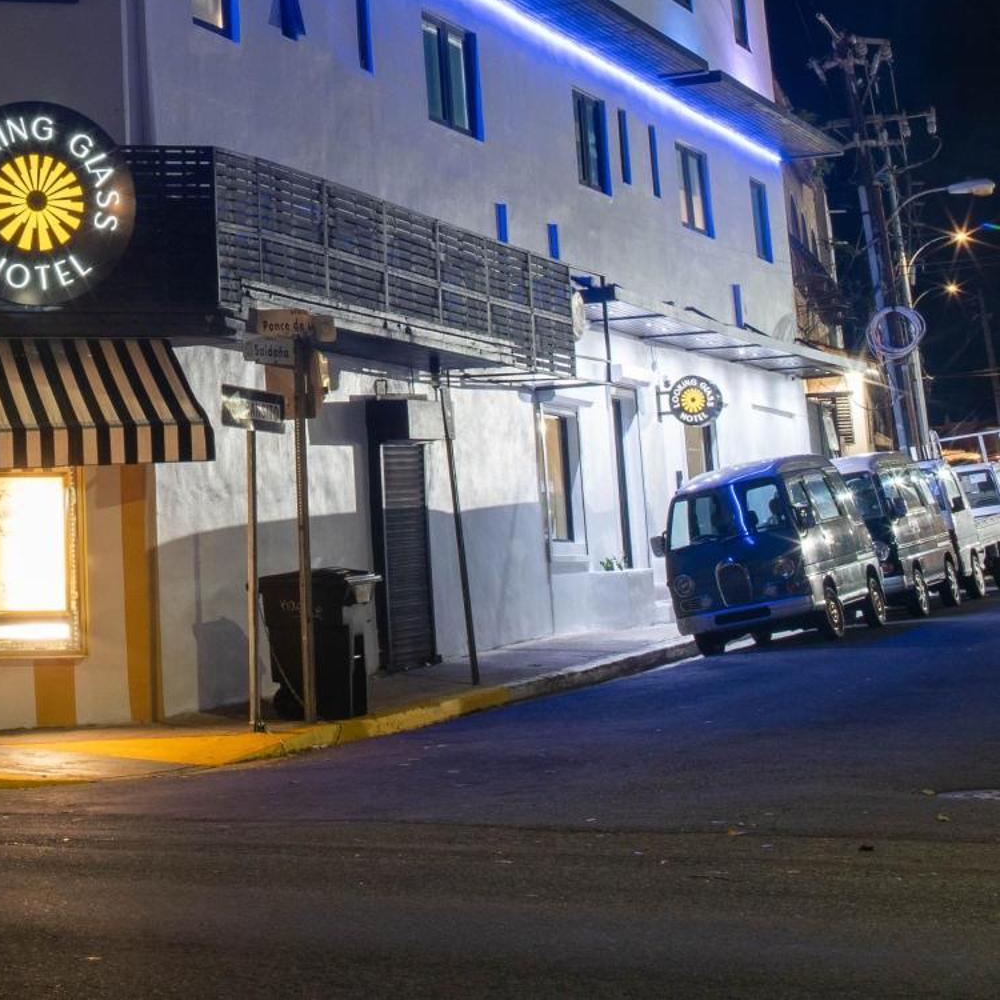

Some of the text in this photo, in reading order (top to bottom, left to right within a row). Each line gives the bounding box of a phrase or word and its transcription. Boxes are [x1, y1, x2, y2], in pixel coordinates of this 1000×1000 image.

[69, 134, 120, 232] GLASS
[262, 320, 290, 332] Ponce
[672, 379, 714, 407] LOOKING GLASS
[680, 412, 708, 422] HOTEL
